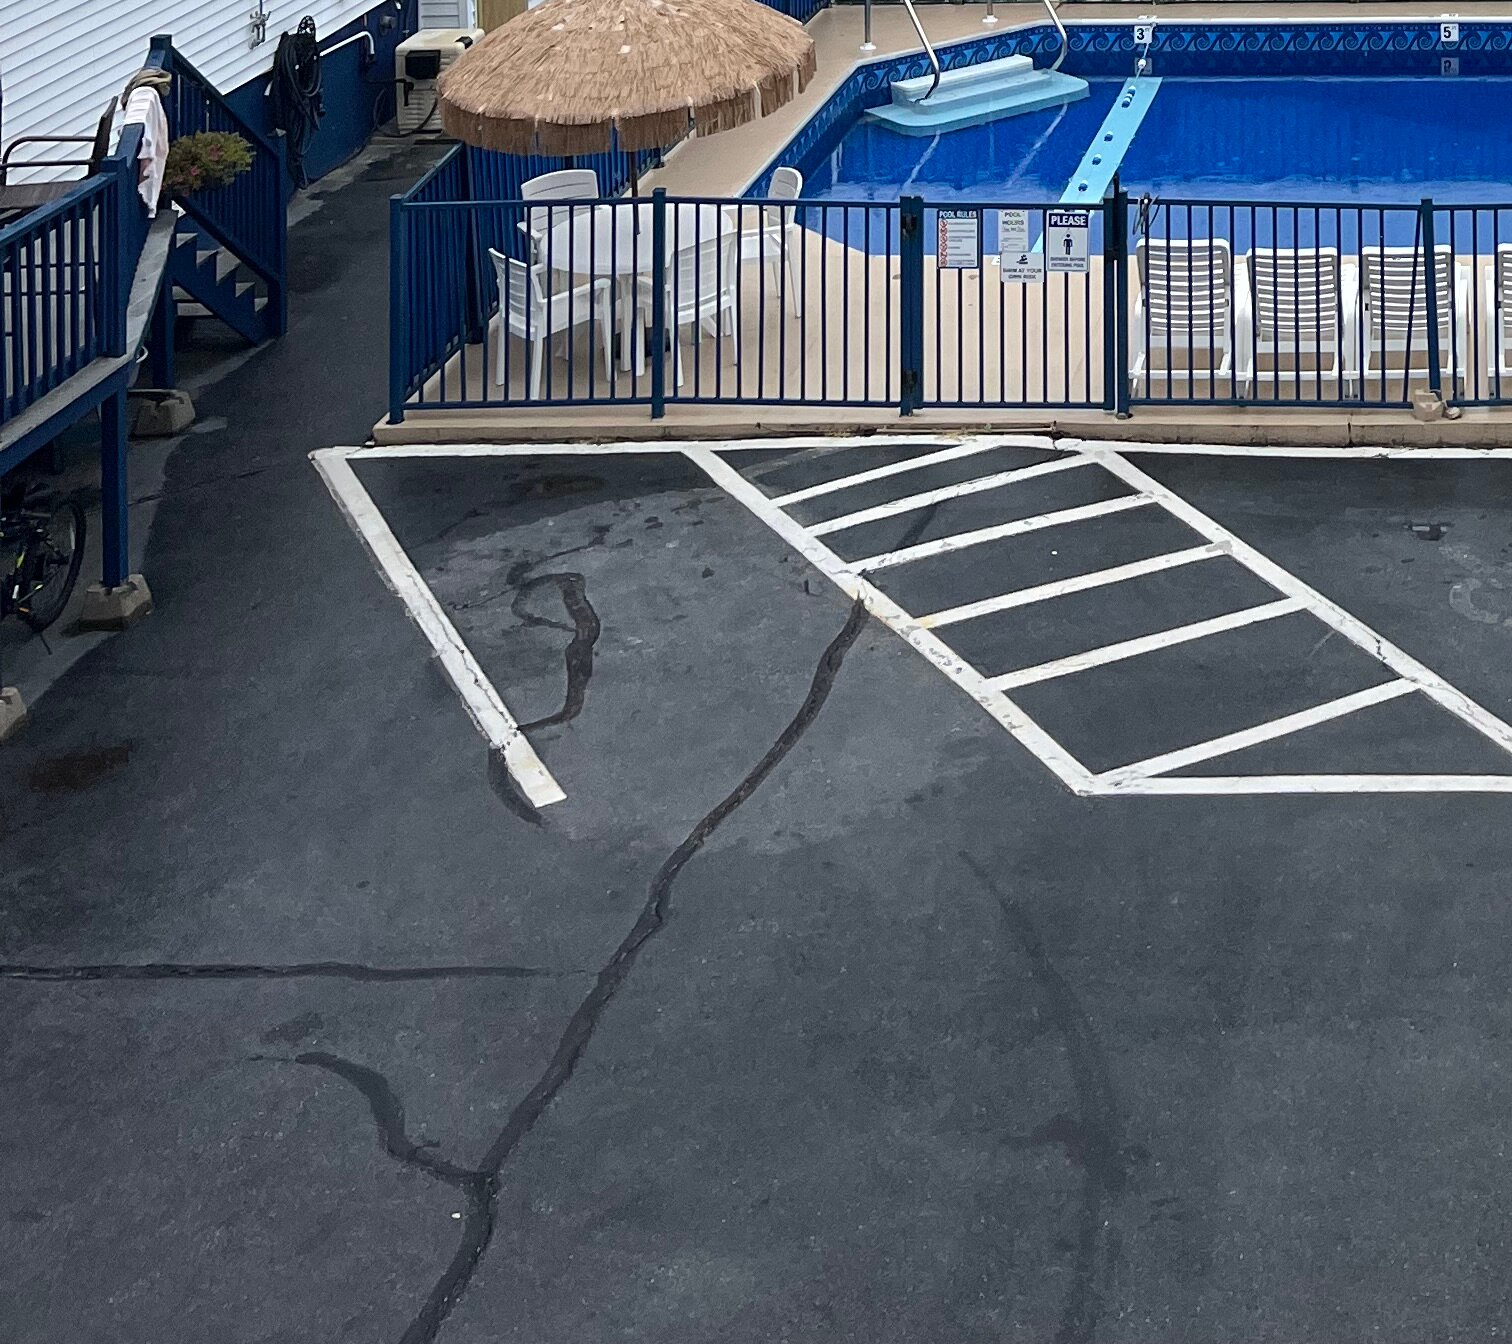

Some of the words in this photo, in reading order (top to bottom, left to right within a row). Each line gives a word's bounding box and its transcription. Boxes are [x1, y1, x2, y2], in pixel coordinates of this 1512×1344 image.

[1136, 27, 1144, 40] 3
[1443, 26, 1451, 39] 5
[939, 210, 955, 218] POOL
[957, 210, 977, 218] RULES
[1050, 216, 1086, 226] PLEASE
